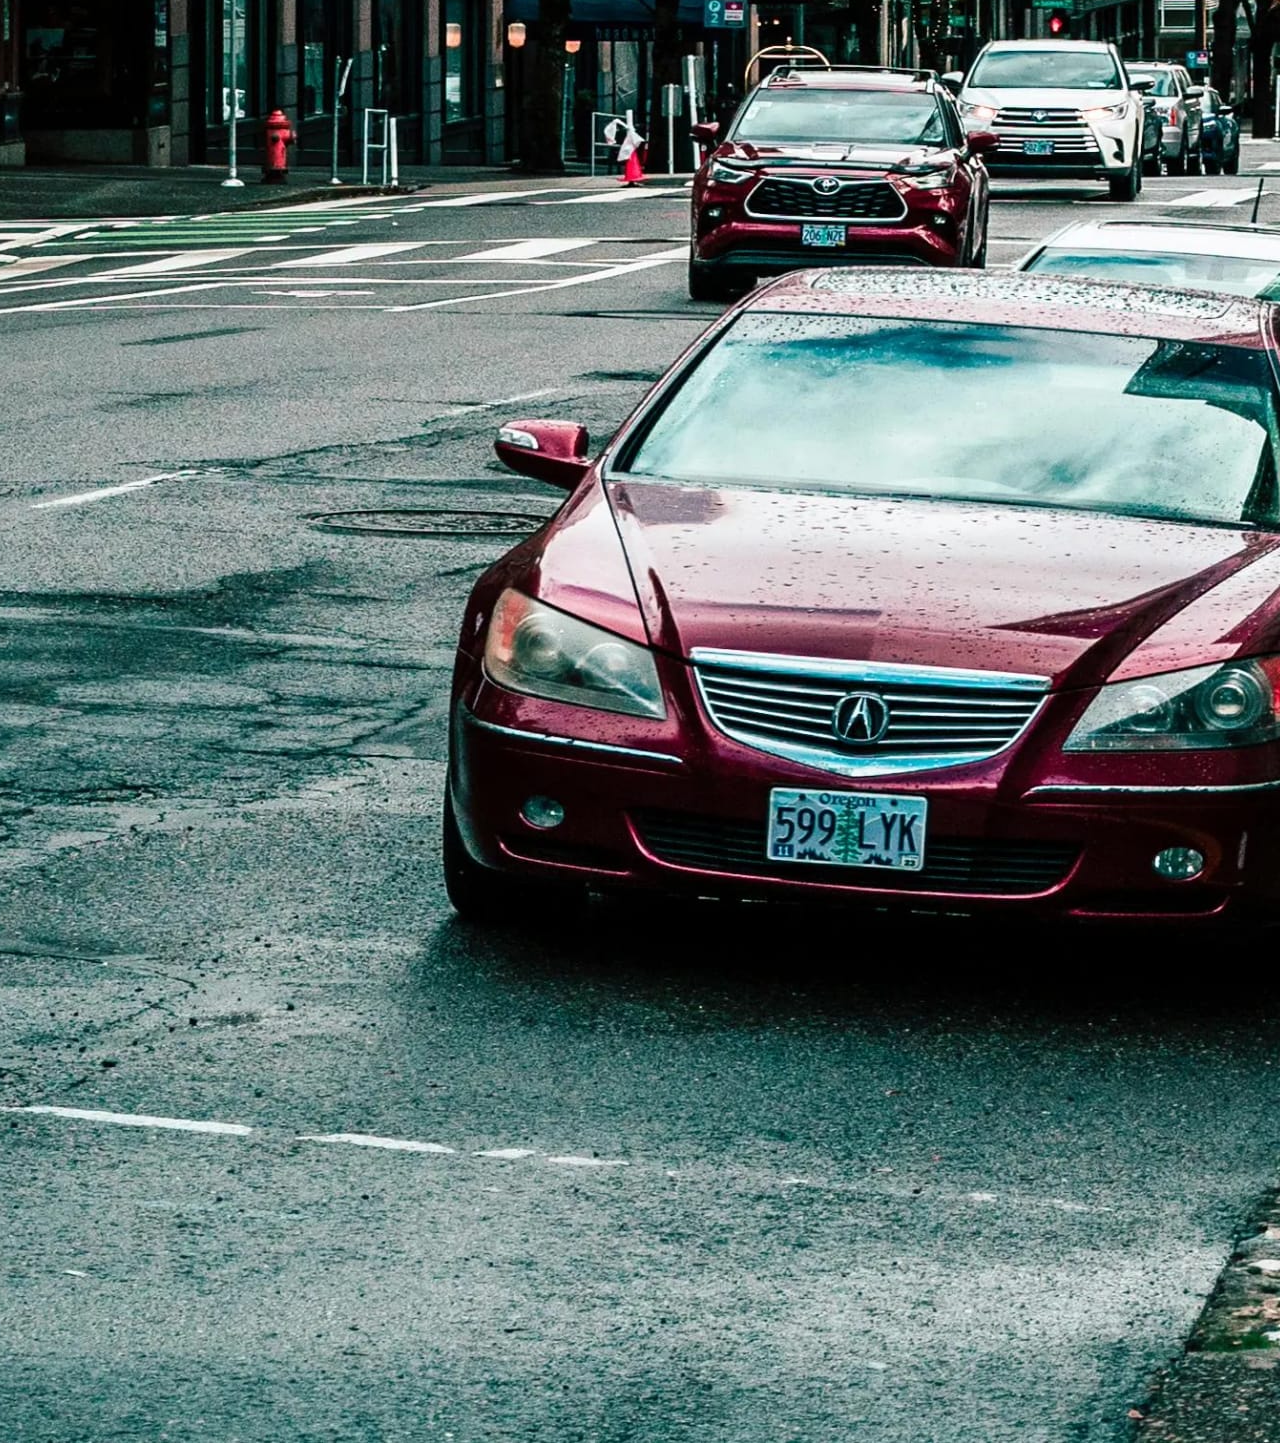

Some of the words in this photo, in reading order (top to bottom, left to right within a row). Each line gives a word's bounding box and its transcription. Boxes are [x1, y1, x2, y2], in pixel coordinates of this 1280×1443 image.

[803, 229, 822, 242] 206
[819, 792, 877, 810] Oregon
[776, 806, 837, 846] 599
[858, 810, 919, 852] LYK
